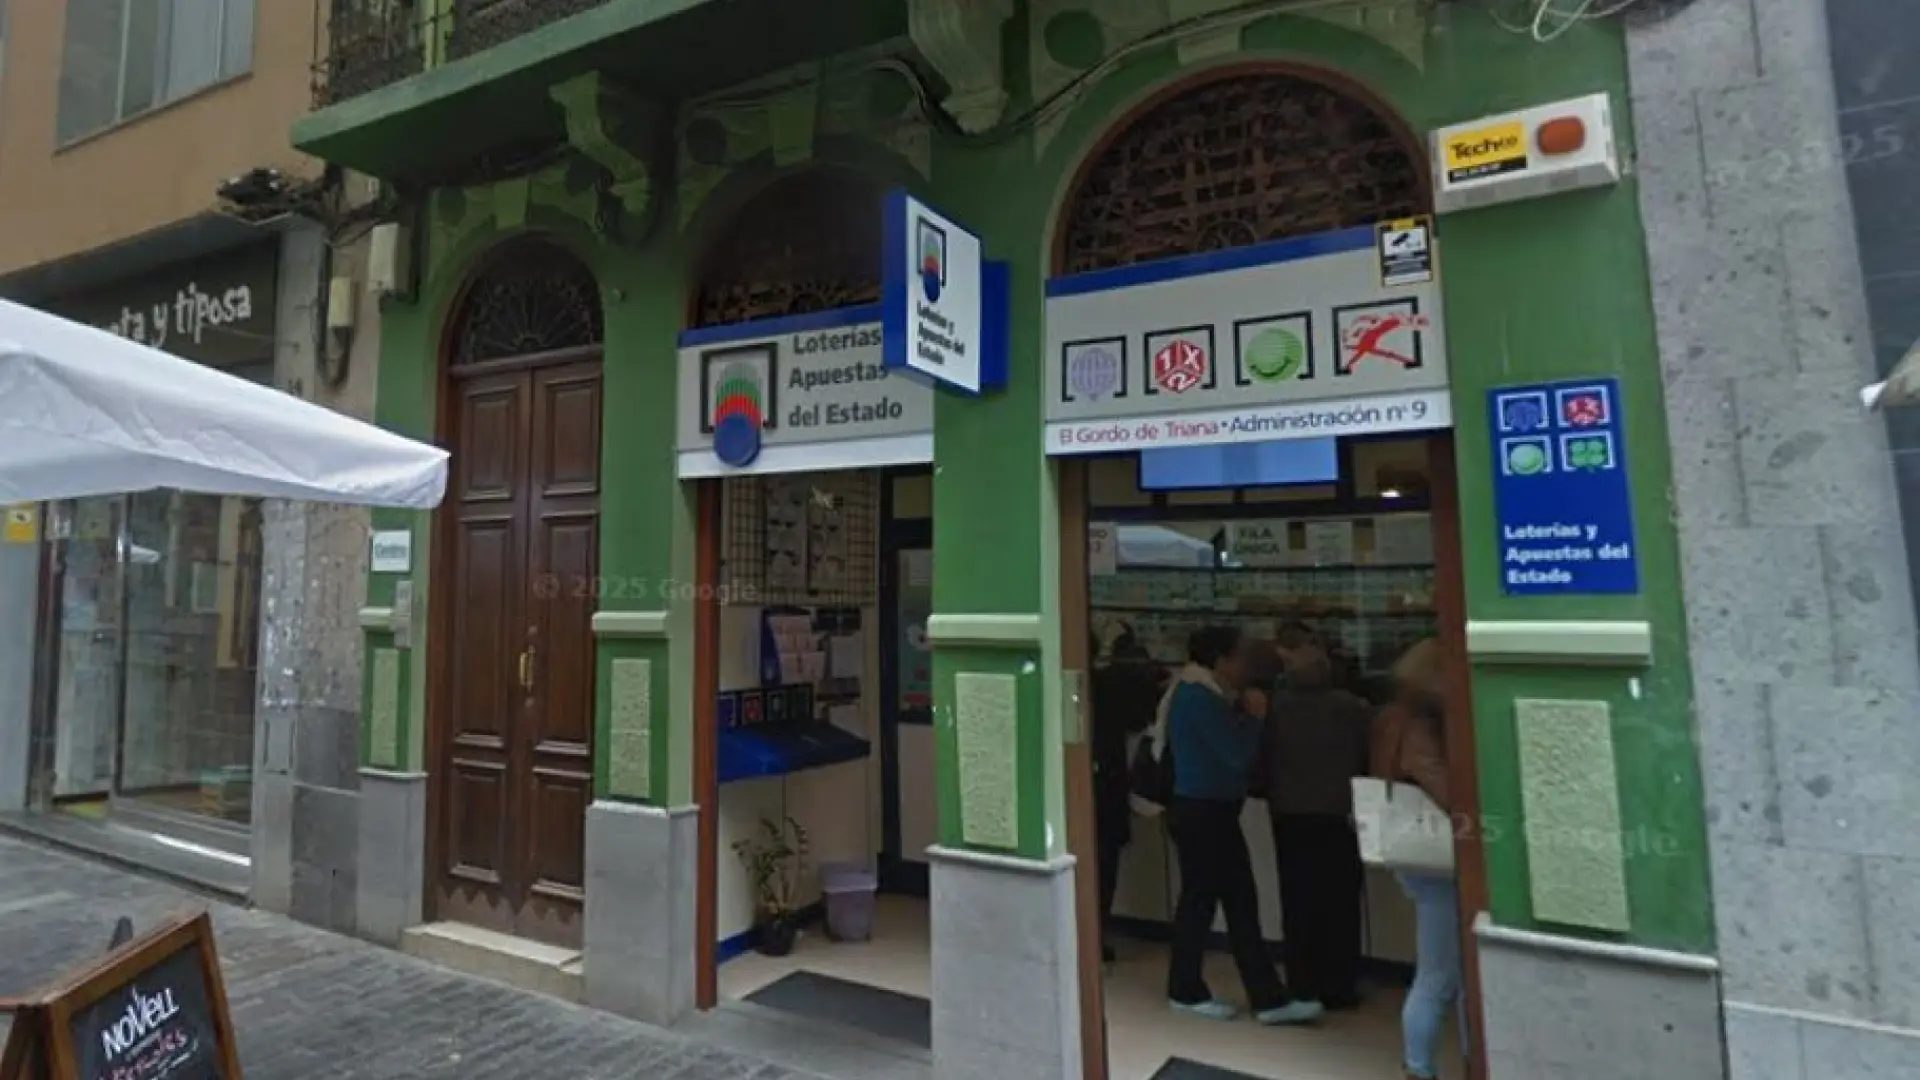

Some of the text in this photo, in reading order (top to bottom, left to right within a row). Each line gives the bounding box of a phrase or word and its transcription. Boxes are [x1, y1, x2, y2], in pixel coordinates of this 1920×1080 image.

[174, 281, 252, 344] tiposa
[788, 361, 889, 391] Apuestas
[788, 397, 903, 428] del Estado
[1076, 424, 1131, 443] Gordo
[1135, 422, 1159, 441] de
[1165, 420, 1219, 438] Triana
[1412, 400, 1428, 418] 9
[1597, 542, 1630, 560] del
[1506, 568, 1573, 584] Estado
